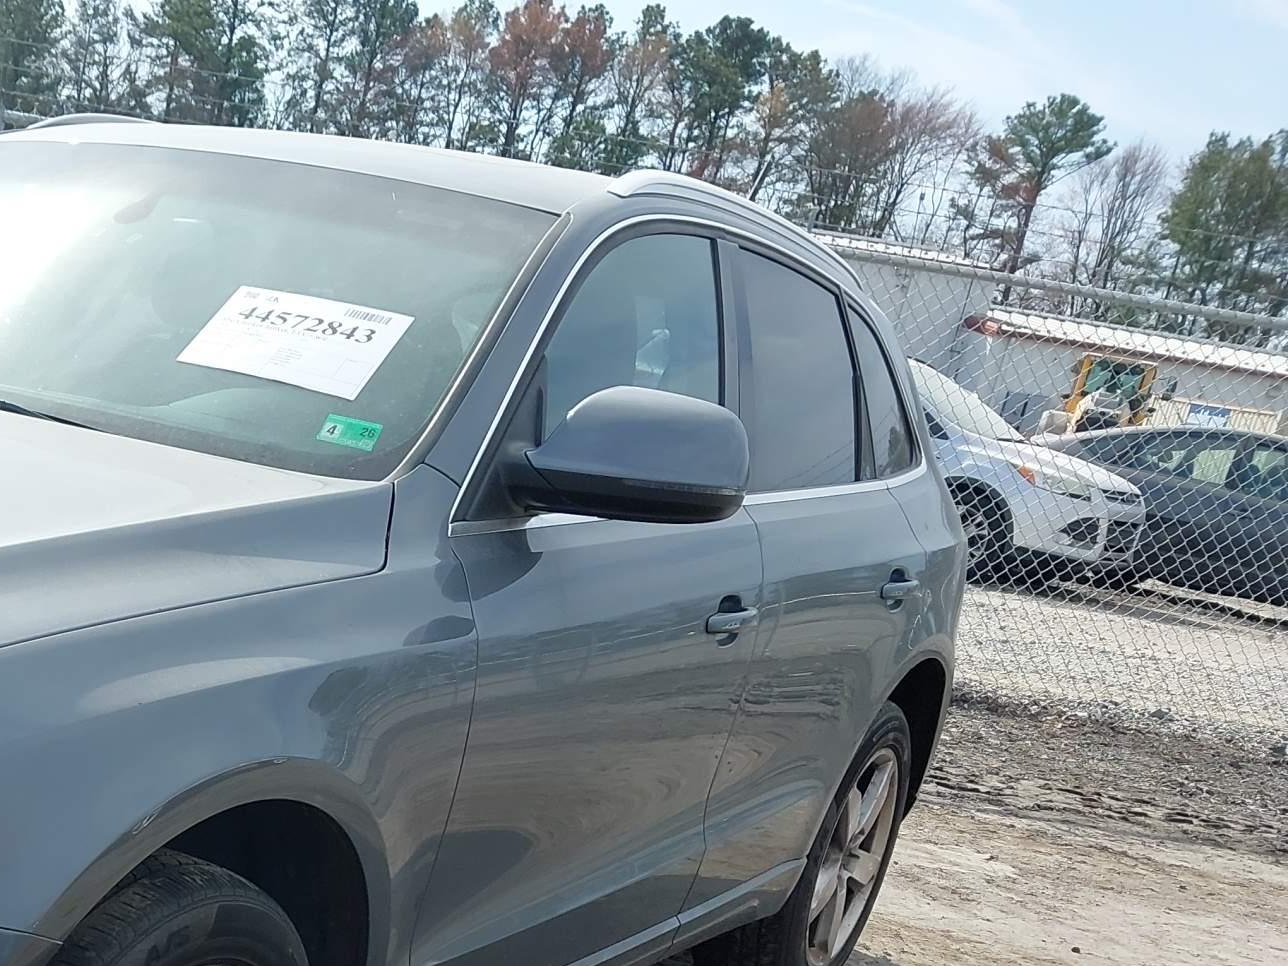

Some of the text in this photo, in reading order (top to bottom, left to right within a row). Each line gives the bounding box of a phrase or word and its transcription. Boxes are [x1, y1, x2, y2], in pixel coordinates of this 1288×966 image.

[237, 306, 377, 344] 44572843
[325, 424, 376, 438] 4 26
